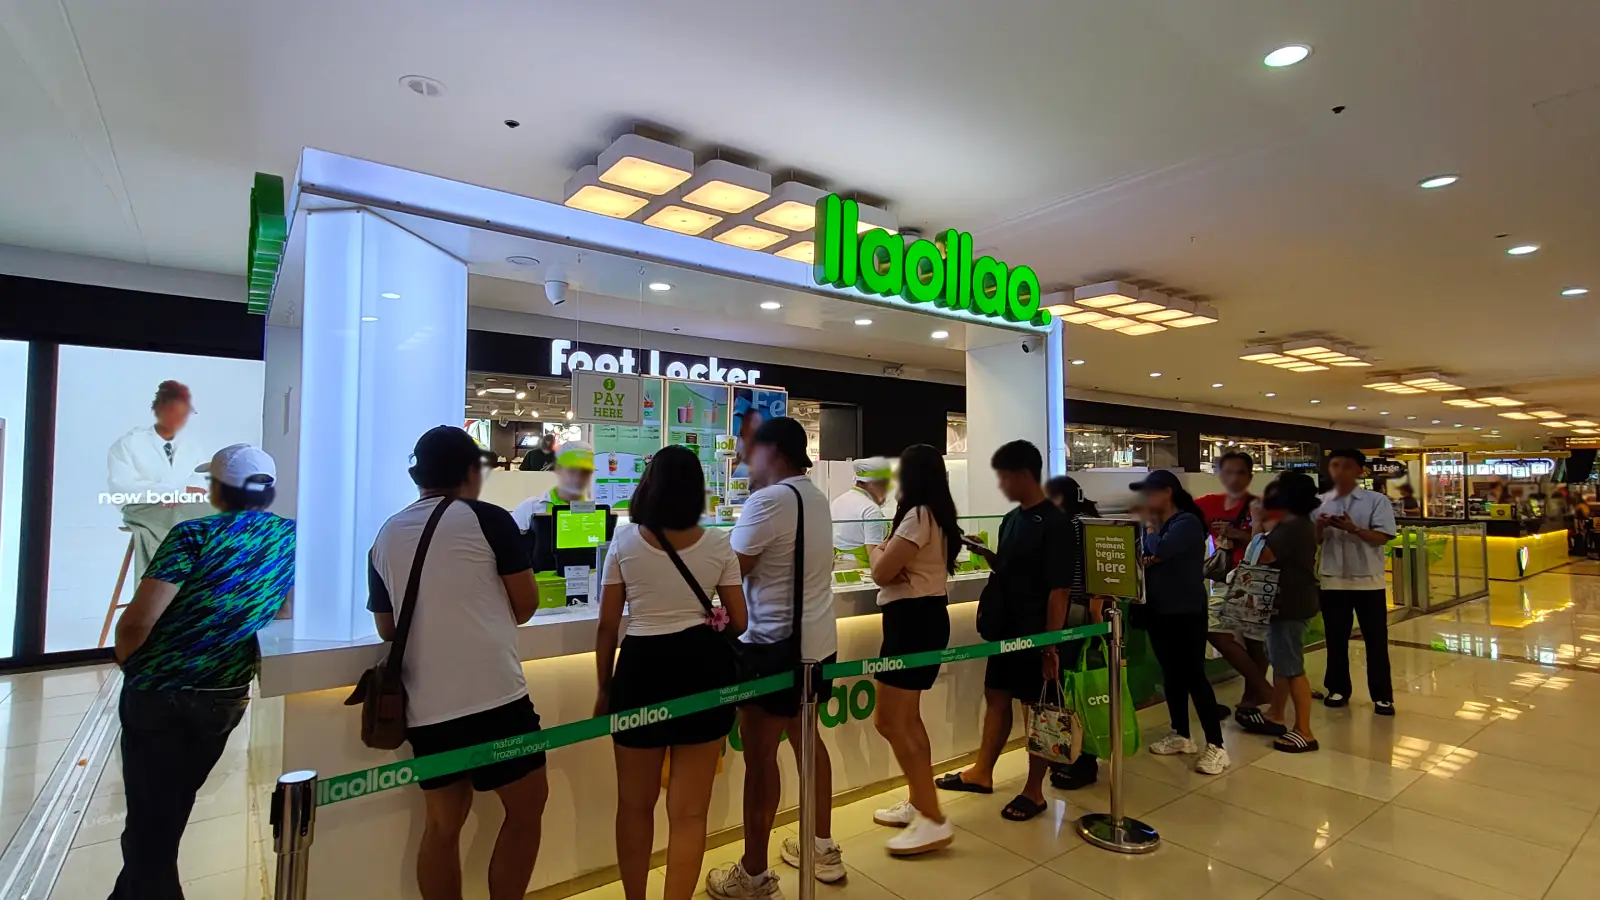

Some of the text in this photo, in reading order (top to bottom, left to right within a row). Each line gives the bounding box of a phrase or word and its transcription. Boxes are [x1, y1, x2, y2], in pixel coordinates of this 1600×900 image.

[815, 192, 1052, 326] llaollao.
[551, 339, 761, 386] Foot Locker
[593, 391, 625, 407] PAY
[593, 407, 624, 419] HERE
[1372, 463, 1400, 474] Liège
[98, 489, 211, 505] new balanc
[1095, 542, 1125, 550] moment
[1095, 549, 1126, 561] begins
[1096, 559, 1126, 574] here
[862, 657, 906, 675] llaollao.
[719, 693, 738, 704] frozen
[1087, 694, 1110, 706] cro
[609, 706, 673, 734] llaollao.
[493, 735, 524, 749] natural
[493, 740, 550, 761] frozen yogurt
[317, 766, 420, 807] llaollao.
